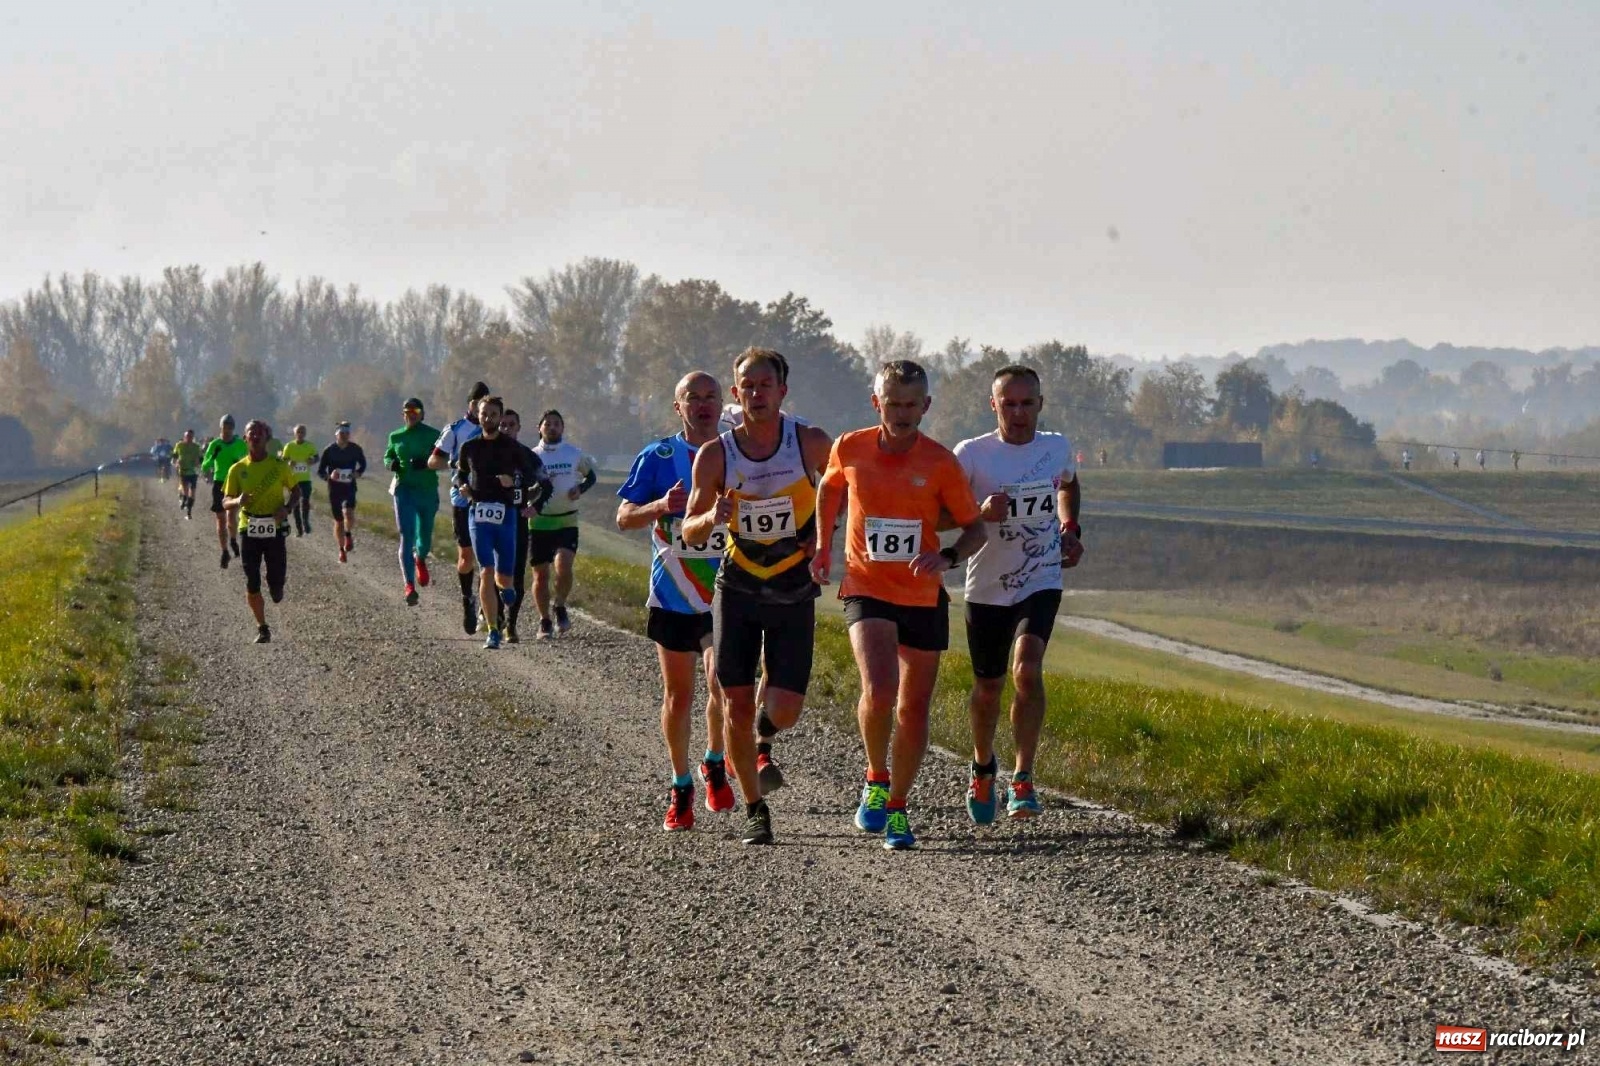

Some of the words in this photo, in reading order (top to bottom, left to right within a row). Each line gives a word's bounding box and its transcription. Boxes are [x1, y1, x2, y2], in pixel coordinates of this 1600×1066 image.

[477, 508, 503, 521] 103
[1007, 494, 1054, 518] 174
[249, 524, 275, 534] 206
[741, 511, 791, 533] 197
[868, 532, 915, 554] 181
